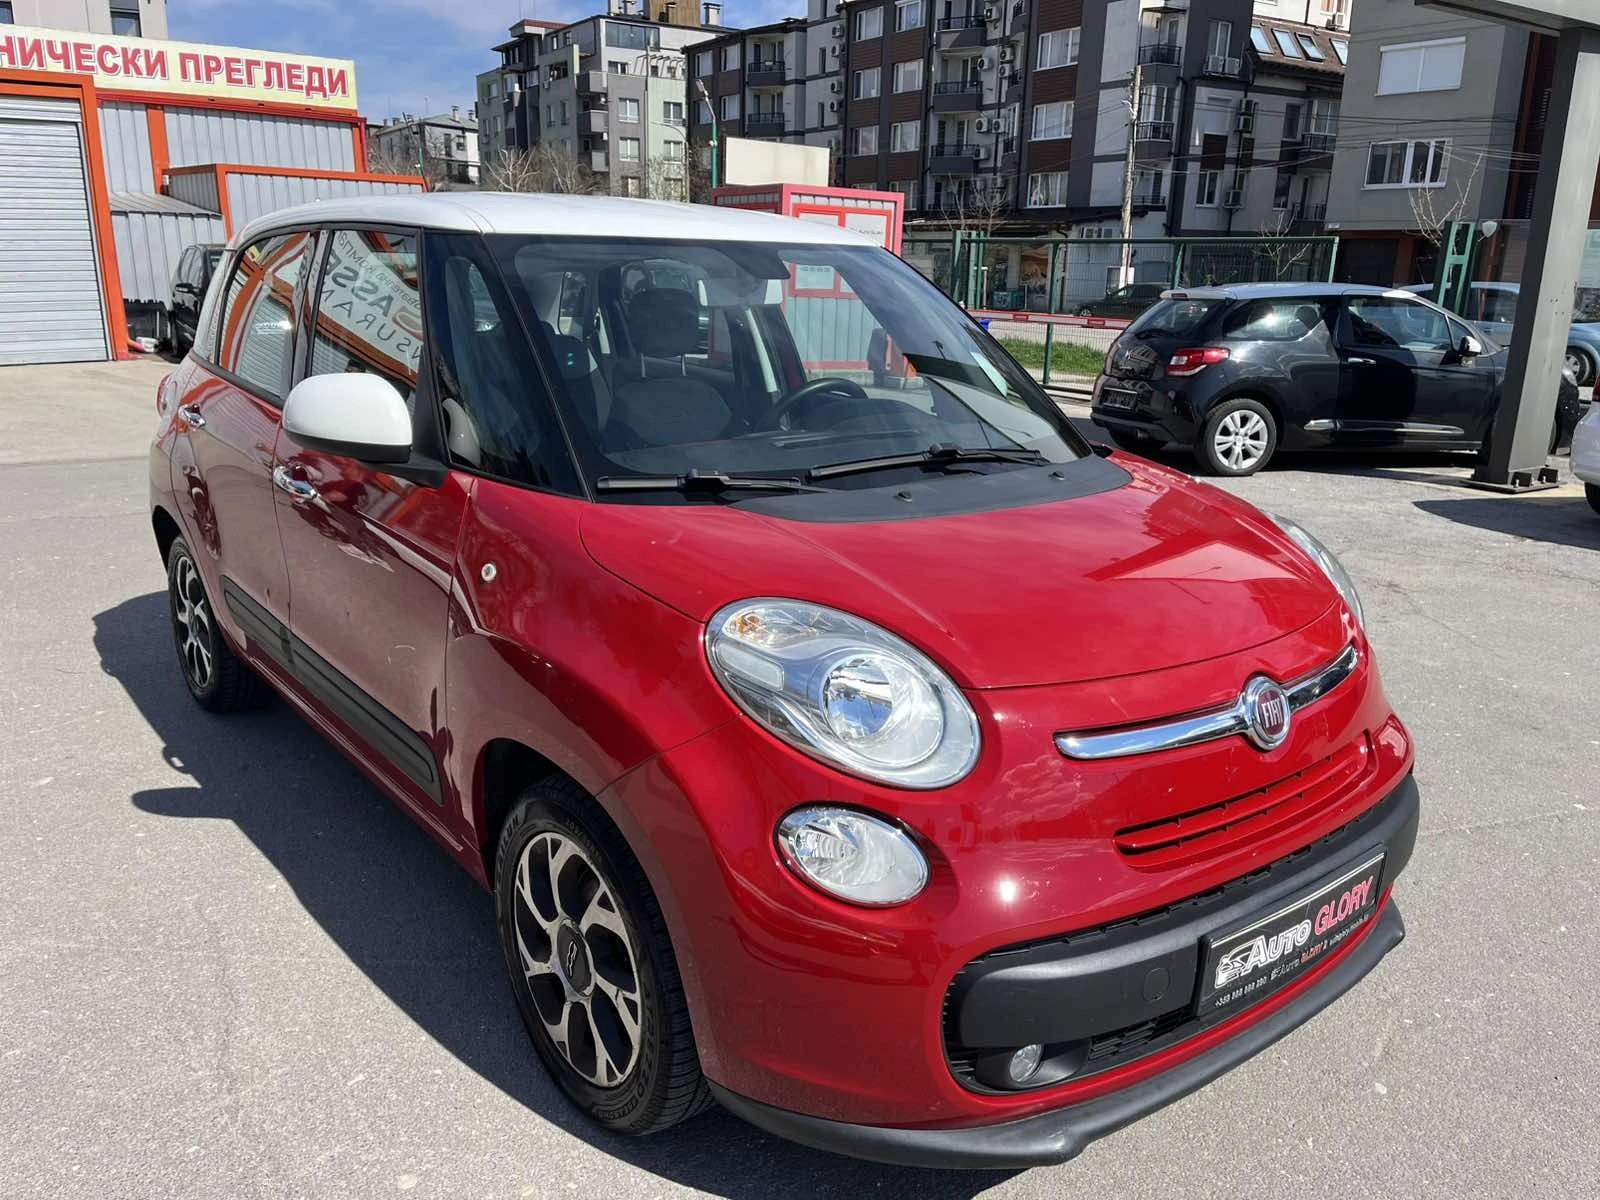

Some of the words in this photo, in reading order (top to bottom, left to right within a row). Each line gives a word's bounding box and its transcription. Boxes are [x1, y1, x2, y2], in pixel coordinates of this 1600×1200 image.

[0, 35, 168, 79] НИЧЕСКИ
[179, 52, 348, 99] ПРЕГЛЕДИ
[1261, 697, 1283, 728] FIAT
[1315, 875, 1374, 935] GLORY
